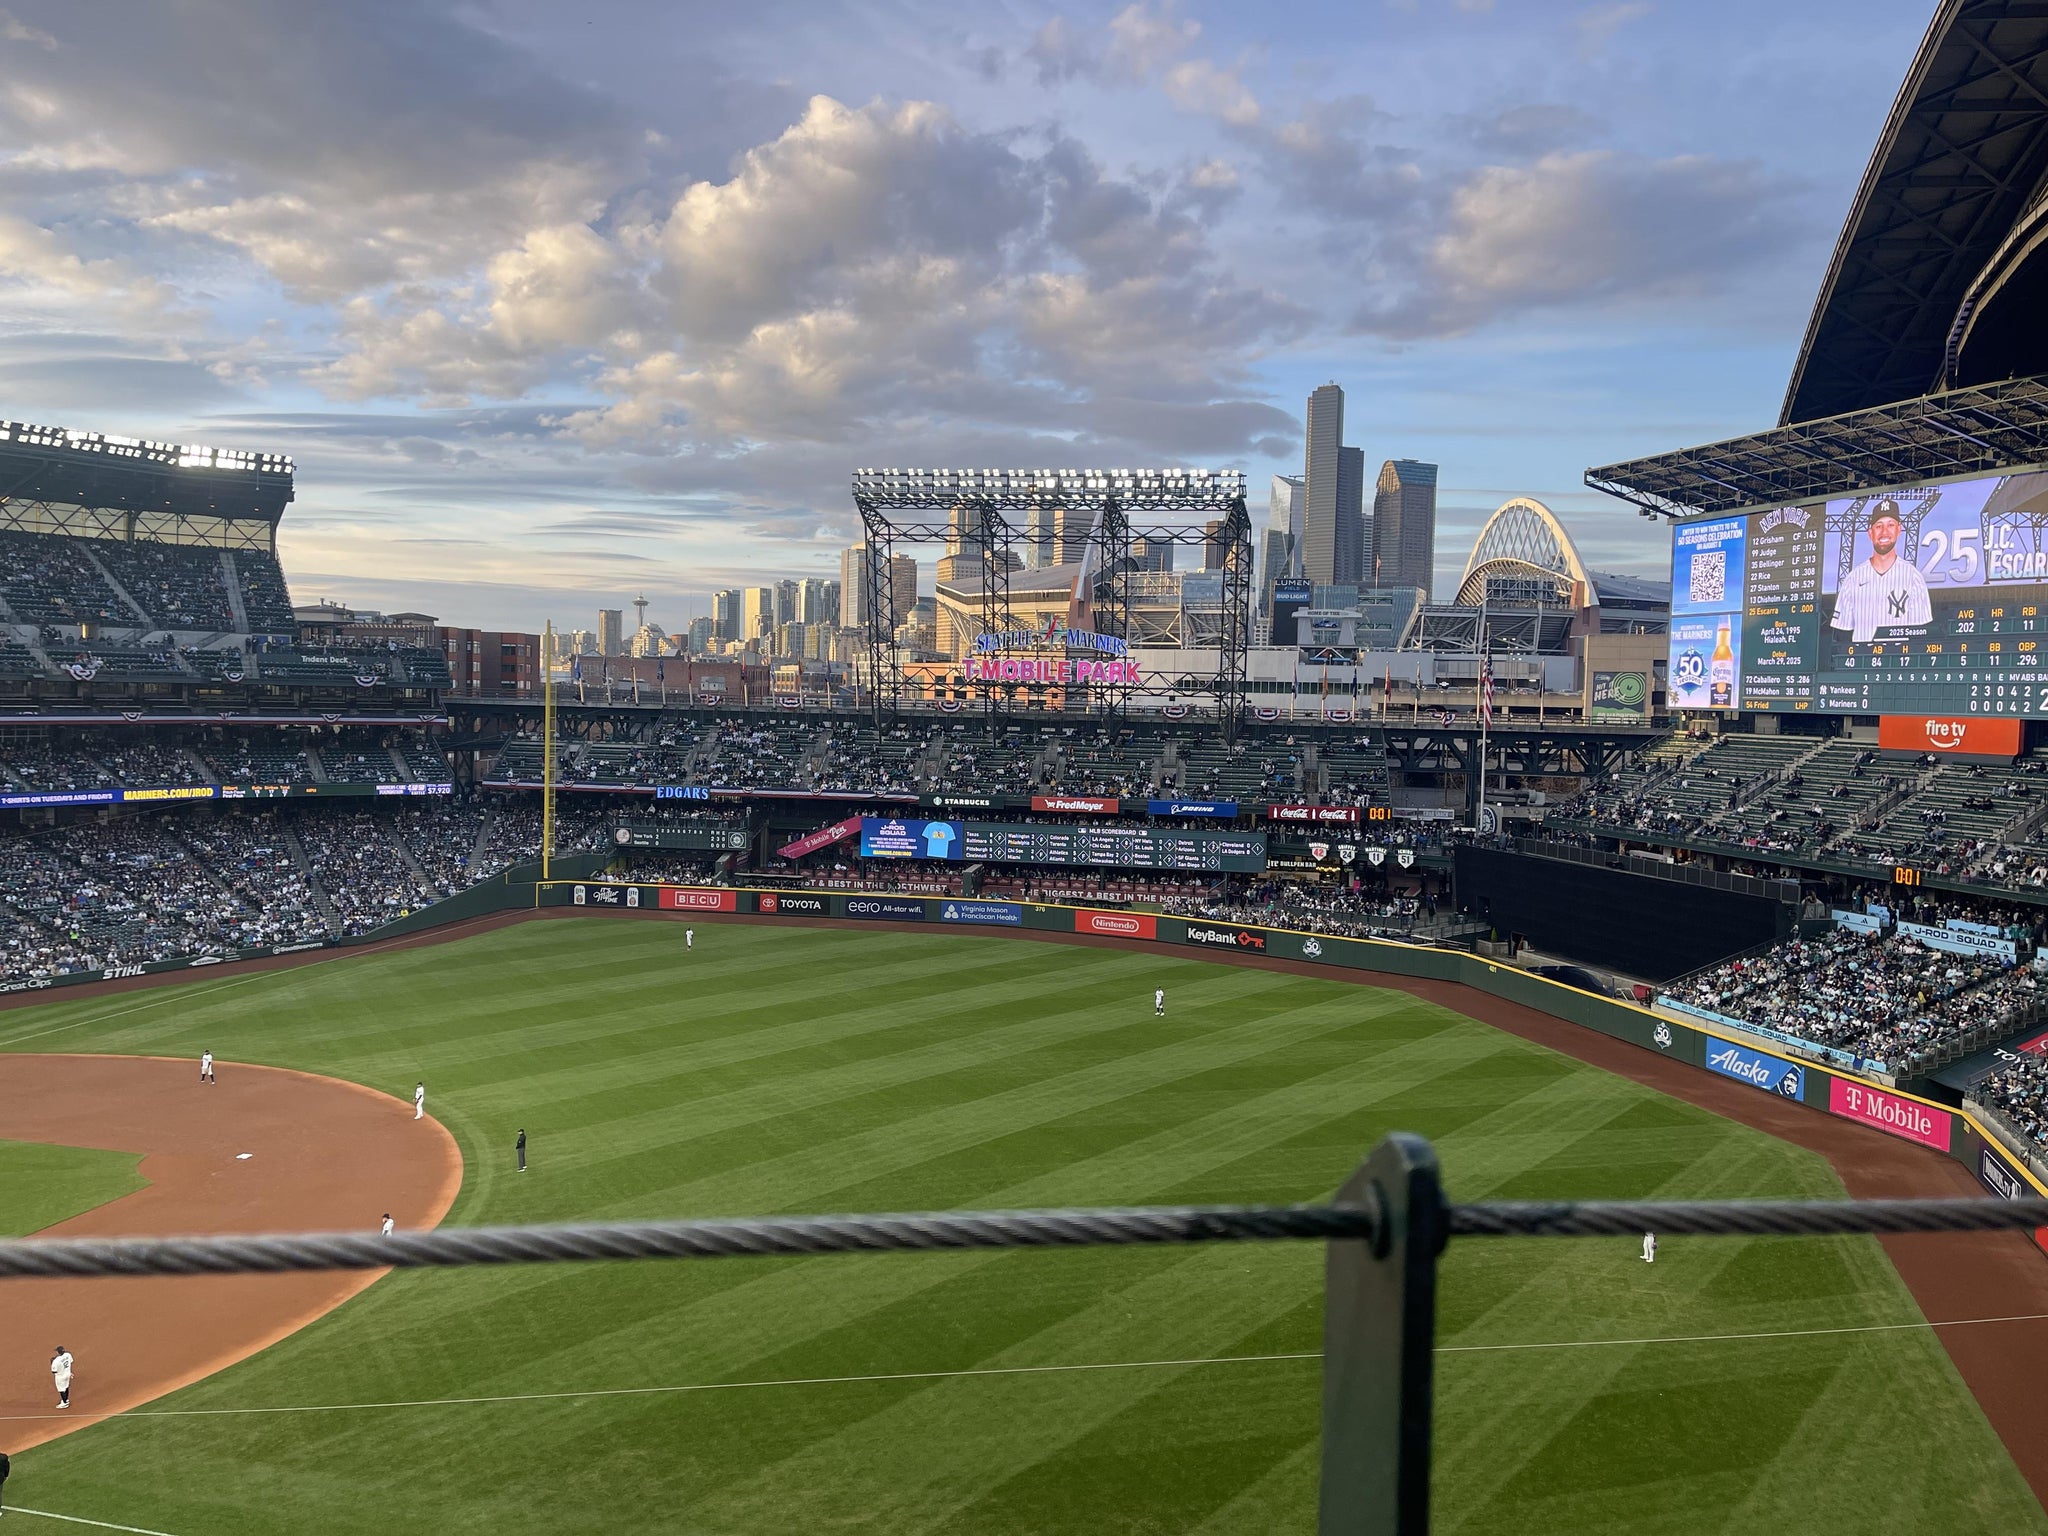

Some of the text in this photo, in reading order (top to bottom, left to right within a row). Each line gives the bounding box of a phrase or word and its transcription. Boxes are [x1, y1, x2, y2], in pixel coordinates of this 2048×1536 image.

[1759, 506, 1811, 533] NEW YORK
[1760, 536, 1784, 544] Grisham
[1793, 533, 1802, 541] CF
[1804, 531, 1817, 539] .143
[1984, 524, 2014, 549] J.C.
[1760, 548, 1776, 557] Judge
[1921, 528, 1979, 582] 25
[1759, 559, 1784, 568] Bellinger
[1990, 550, 2048, 579] ESCAR
[1759, 572, 1770, 580] Rice
[1792, 569, 1799, 577] 1B
[1802, 568, 1815, 576] .308
[1758, 584, 1779, 592] Stanton
[1801, 580, 1814, 588] .529
[1757, 595, 1780, 604] Chisholm
[1790, 593, 1798, 601] 2B
[1757, 607, 1778, 615] Escarra
[1800, 605, 1813, 613] .000
[1958, 607, 2036, 619] AVG HR RBI
[1761, 628, 1775, 636] April
[1956, 620, 2033, 633] .202 2 11
[976, 629, 1128, 655] SEATTLE MARINERS
[1765, 636, 1787, 644] Hialeah,
[1873, 643, 2036, 654] AB XBH BB OBP
[1680, 656, 1702, 676] 50
[1845, 655, 2037, 667] 40 84 17 11 .296
[962, 658, 1142, 682] T-MOBILE PARK
[1753, 675, 1780, 683] Caballero
[1796, 675, 1810, 683] .286
[1594, 687, 1620, 701] HERE
[1830, 686, 1855, 694] Yankees
[1754, 701, 1769, 709] Fried
[1830, 700, 1856, 708] Mariners
[1926, 720, 1965, 737] fire tv
[124, 788, 213, 800] MARINERS.COM/JROD
[656, 786, 709, 799] EDGAR'S
[945, 798, 989, 806] STARBUCKS
[1370, 808, 1391, 820] 0:01
[810, 834, 829, 845] Mobile
[1314, 849, 1323, 857] 42
[1343, 851, 1351, 859] 24
[1373, 853, 1380, 861] 11
[1895, 867, 1920, 886] 0:01
[828, 880, 851, 888] BEST
[866, 881, 884, 889] THE
[1097, 892, 1121, 900] BEST
[1124, 893, 1134, 901] IN
[1137, 894, 1156, 902] THE
[781, 900, 821, 910] TOYOTA
[848, 901, 880, 913] eero
[882, 905, 908, 913] All-star
[961, 905, 985, 913] Virginia
[961, 912, 995, 920] Franciscan
[1095, 918, 1135, 930] Nintendo
[1188, 928, 1236, 944] KeyBank
[1914, 927, 1996, 949] J-ROD SQUAD
[1306, 942, 1318, 950] 50
[103, 965, 146, 979] STIHL
[0, 979, 52, 992] Great Clips
[1656, 1030, 1669, 1039] 50
[1735, 1022, 1788, 1042] J-ROD SQUAD
[1710, 1049, 1770, 1083] Alaska
[1846, 1087, 1932, 1135] T Mobile
